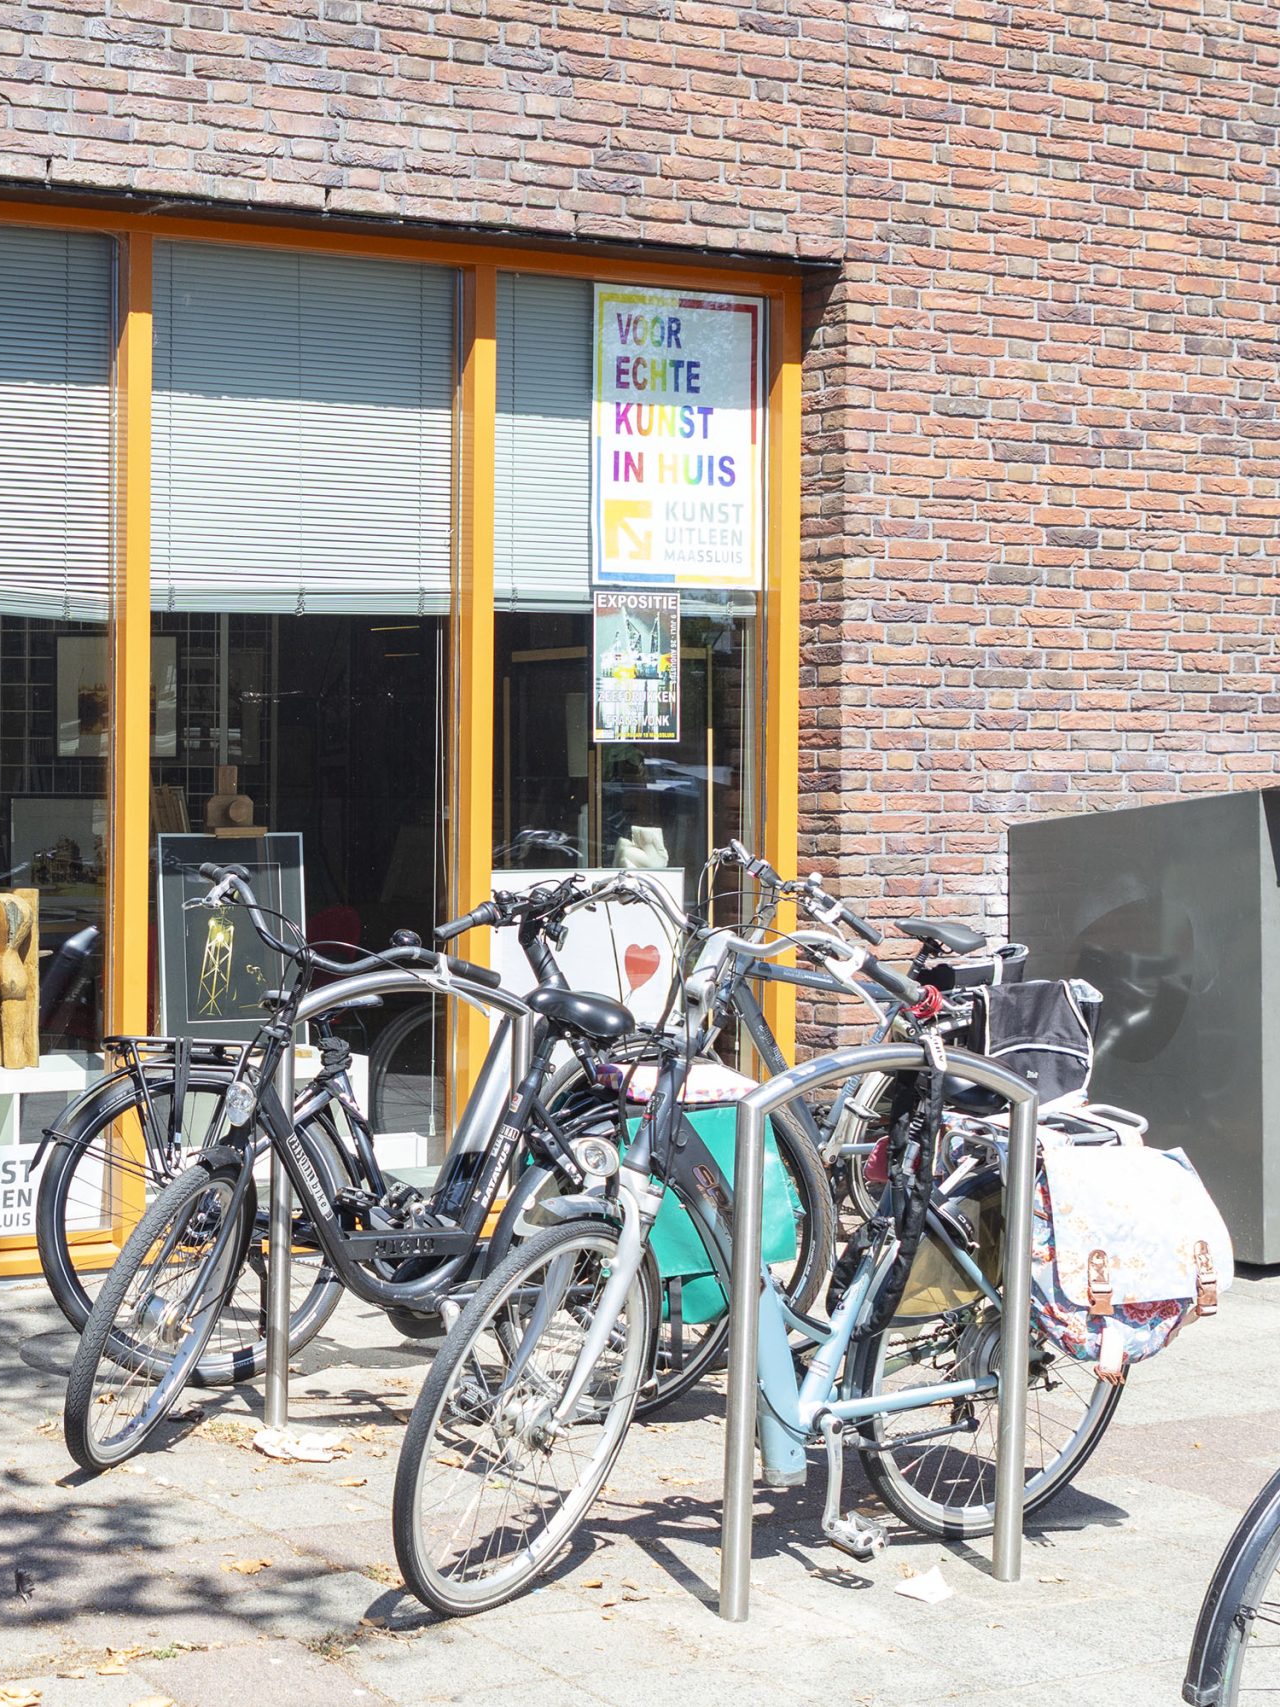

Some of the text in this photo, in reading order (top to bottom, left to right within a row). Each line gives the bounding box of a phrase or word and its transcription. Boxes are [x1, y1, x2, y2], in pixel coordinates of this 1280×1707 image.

[616, 312, 682, 349] VOOR
[615, 355, 701, 394] ECHTE
[615, 401, 714, 439] KUNST
[613, 450, 736, 487] IN HUIS
[664, 501, 745, 524] KUNST
[664, 526, 744, 547] UITLEEN
[663, 548, 743, 564] MAASSLUIS
[597, 594, 678, 610] EXPOSITIE
[669, 649, 677, 685] AUGUSTUS
[643, 714, 670, 727] VONK
[480, 1141, 512, 1209] BATAVUS
